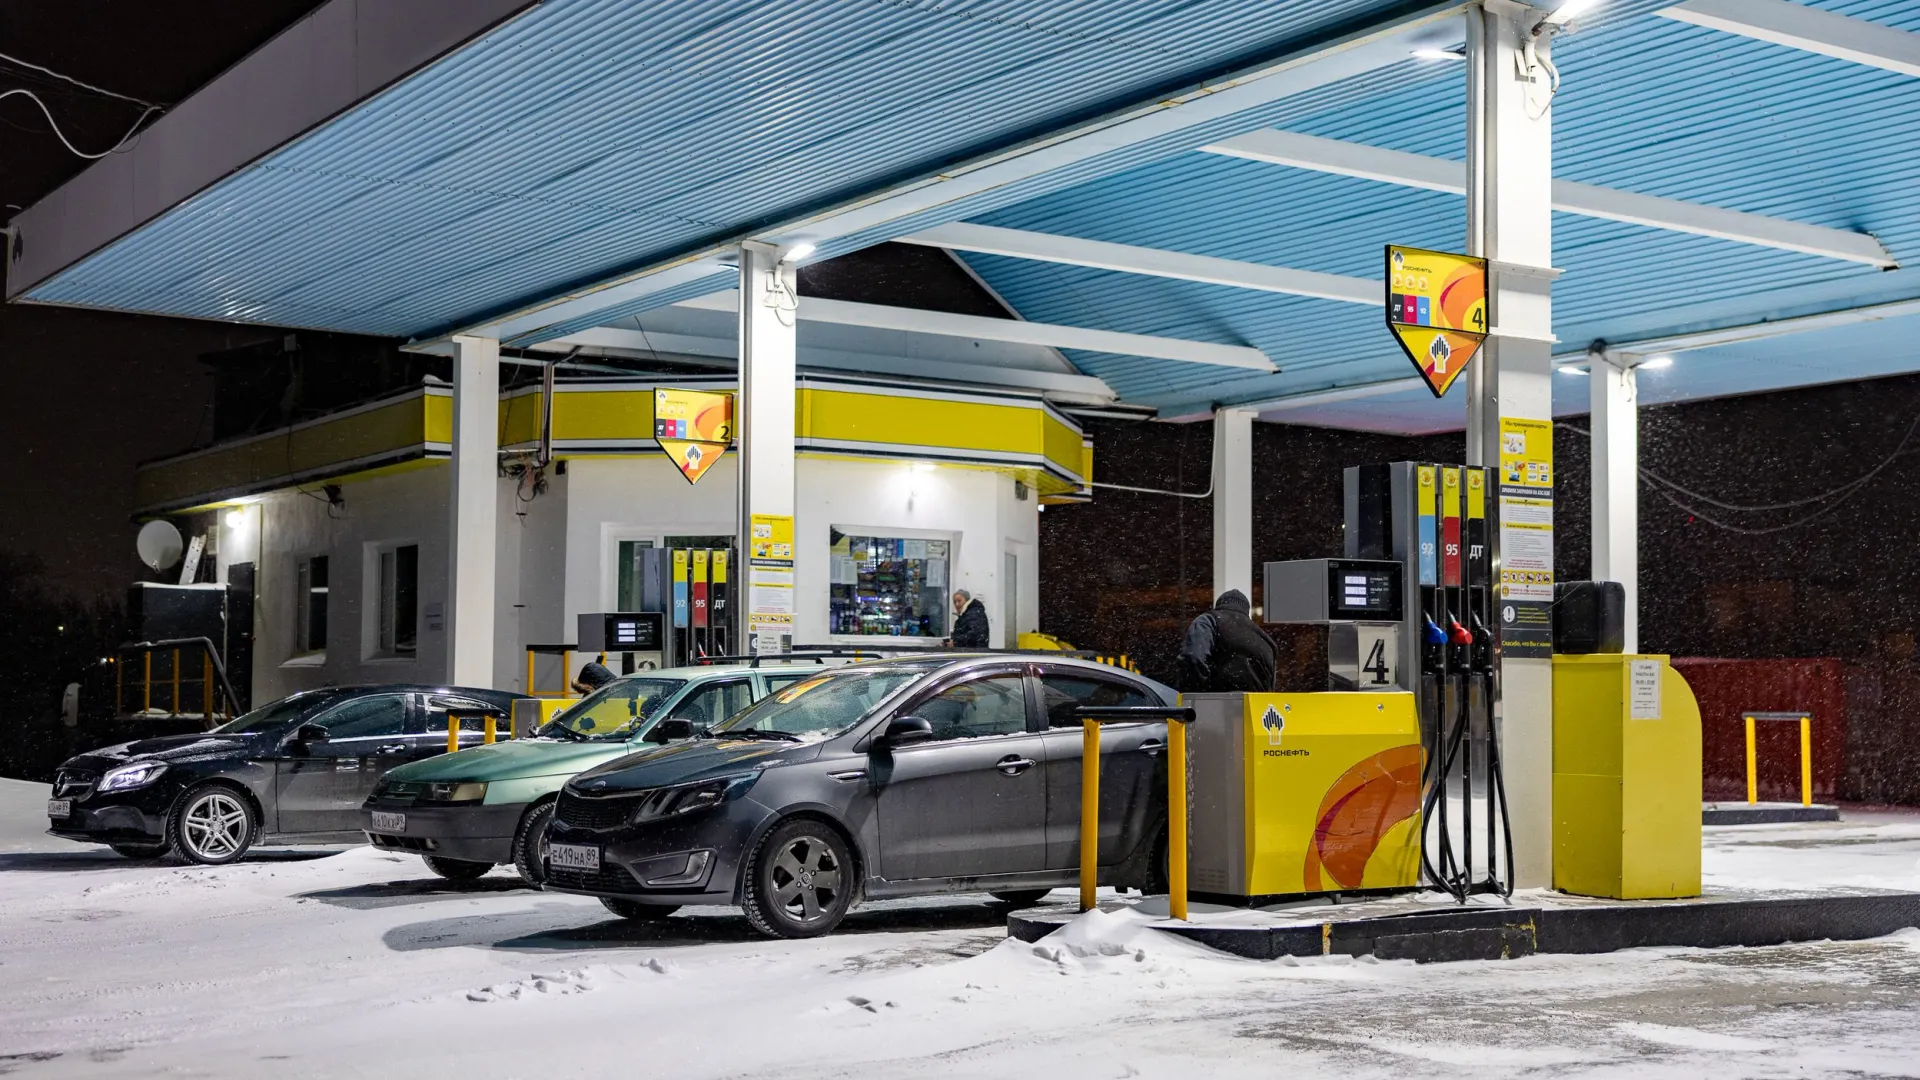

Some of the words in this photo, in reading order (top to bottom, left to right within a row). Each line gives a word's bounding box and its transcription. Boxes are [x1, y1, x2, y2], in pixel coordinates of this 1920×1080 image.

[1420, 307, 1427, 315] 92
[1472, 307, 1484, 327] 4
[720, 425, 730, 441] 2
[1421, 542, 1433, 555] 92
[1446, 543, 1458, 556] 95
[1469, 544, 1484, 560] ДТ
[675, 599, 686, 608] 92
[695, 599, 706, 608] 95
[714, 599, 726, 610] ДТ
[1362, 638, 1390, 685] 4
[1263, 749, 1310, 757] РОСНЕФТЬ
[552, 846, 585, 865] Е419НА
[586, 848, 596, 862] 89
